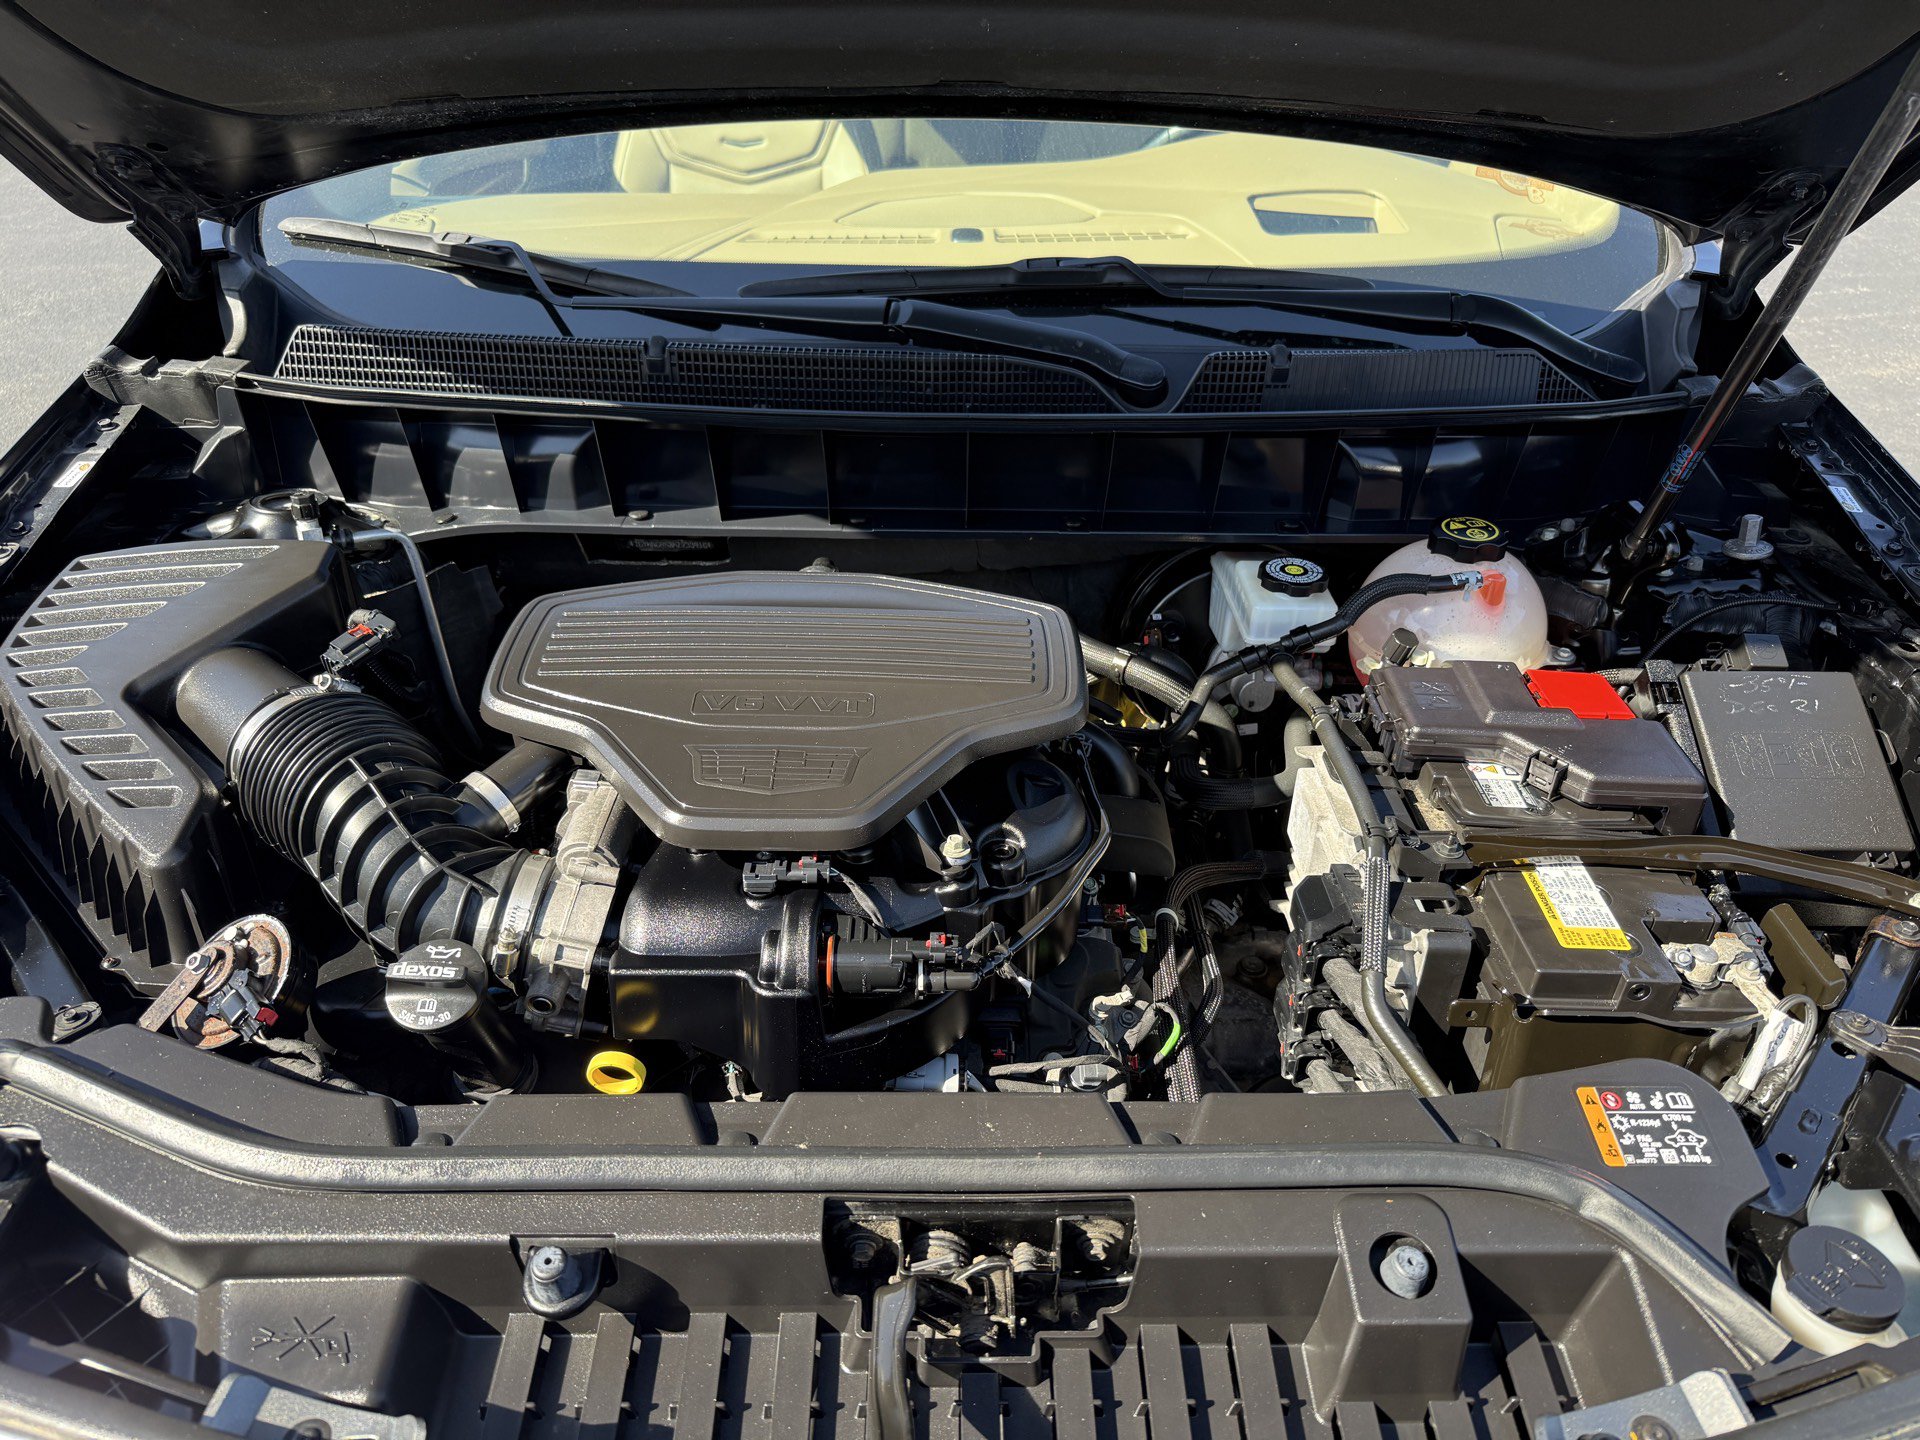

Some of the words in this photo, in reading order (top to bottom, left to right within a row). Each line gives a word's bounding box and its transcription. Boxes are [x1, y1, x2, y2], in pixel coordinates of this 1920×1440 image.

[702, 695, 765, 711] V6
[775, 695, 868, 713] VVT
[1790, 698, 1819, 714] 21
[1482, 784, 1499, 802] 3786
[392, 961, 459, 978] dexos
[399, 1009, 416, 1024] SAE
[418, 1010, 452, 1026] 5W-30
